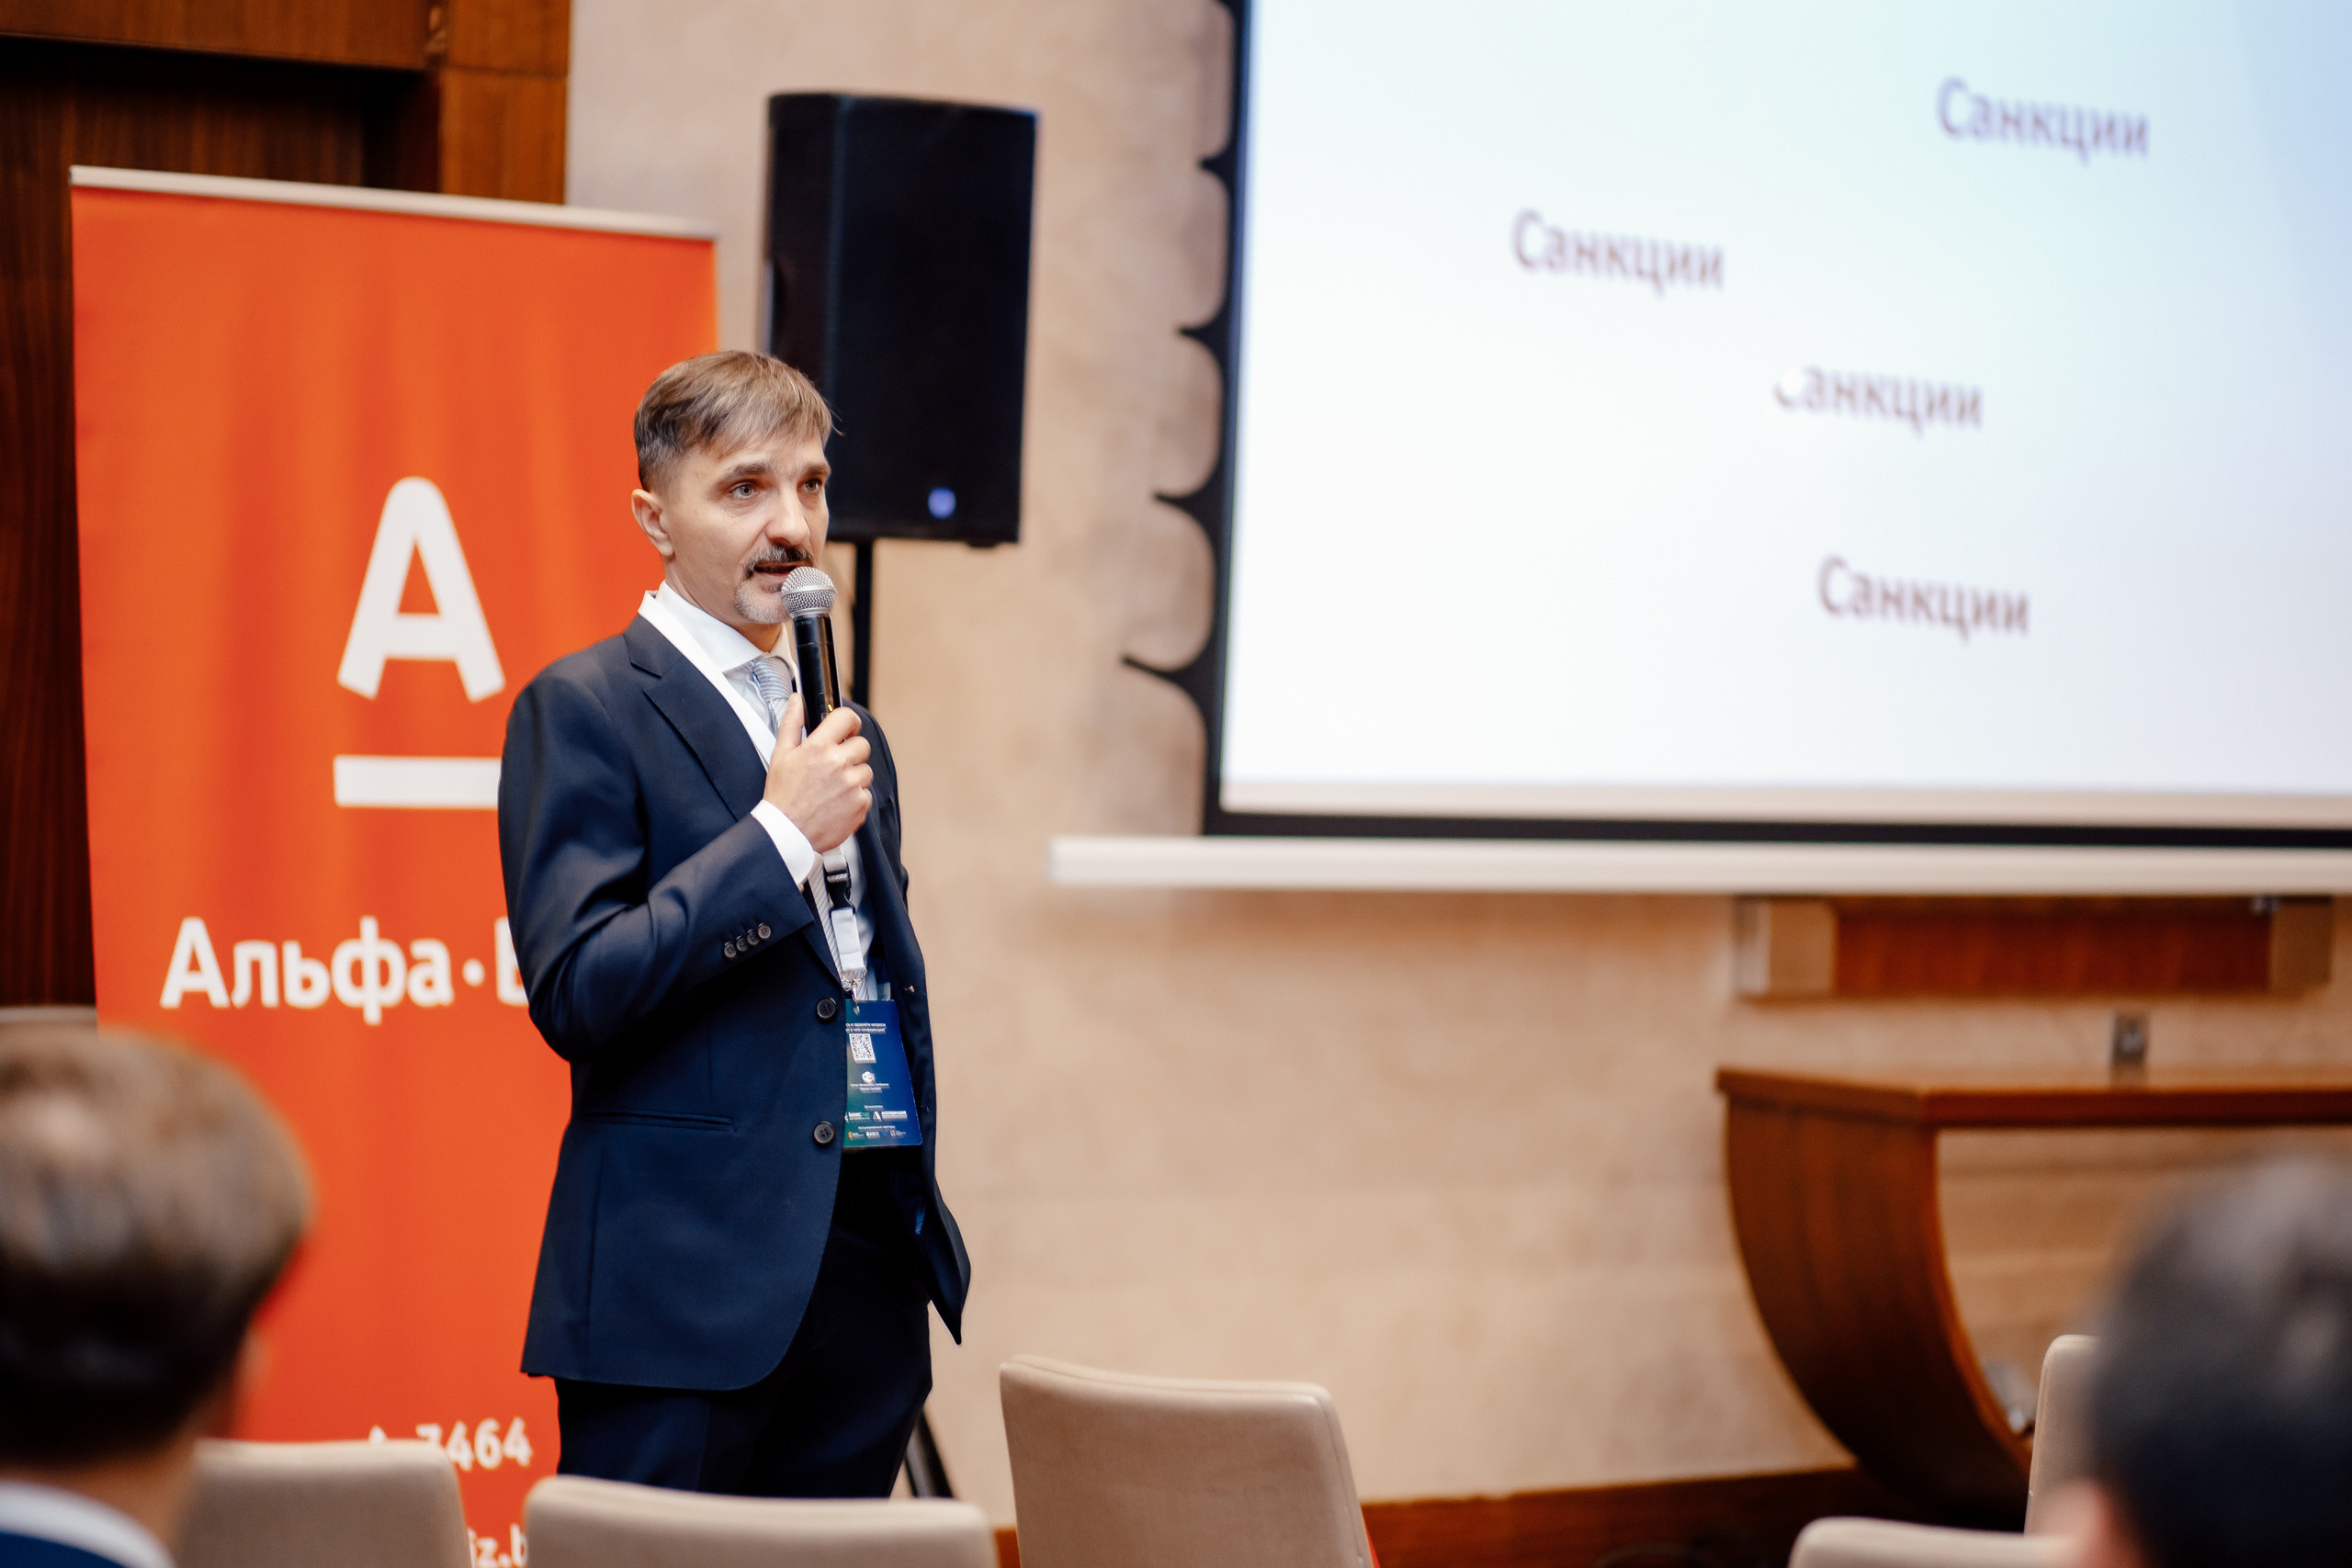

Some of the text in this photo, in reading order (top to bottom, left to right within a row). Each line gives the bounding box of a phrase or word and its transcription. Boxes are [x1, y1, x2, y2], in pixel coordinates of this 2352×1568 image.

[1936, 77, 2148, 166] Санкции
[1511, 208, 1724, 298] Санкции
[1816, 554, 2030, 643] Санкции
